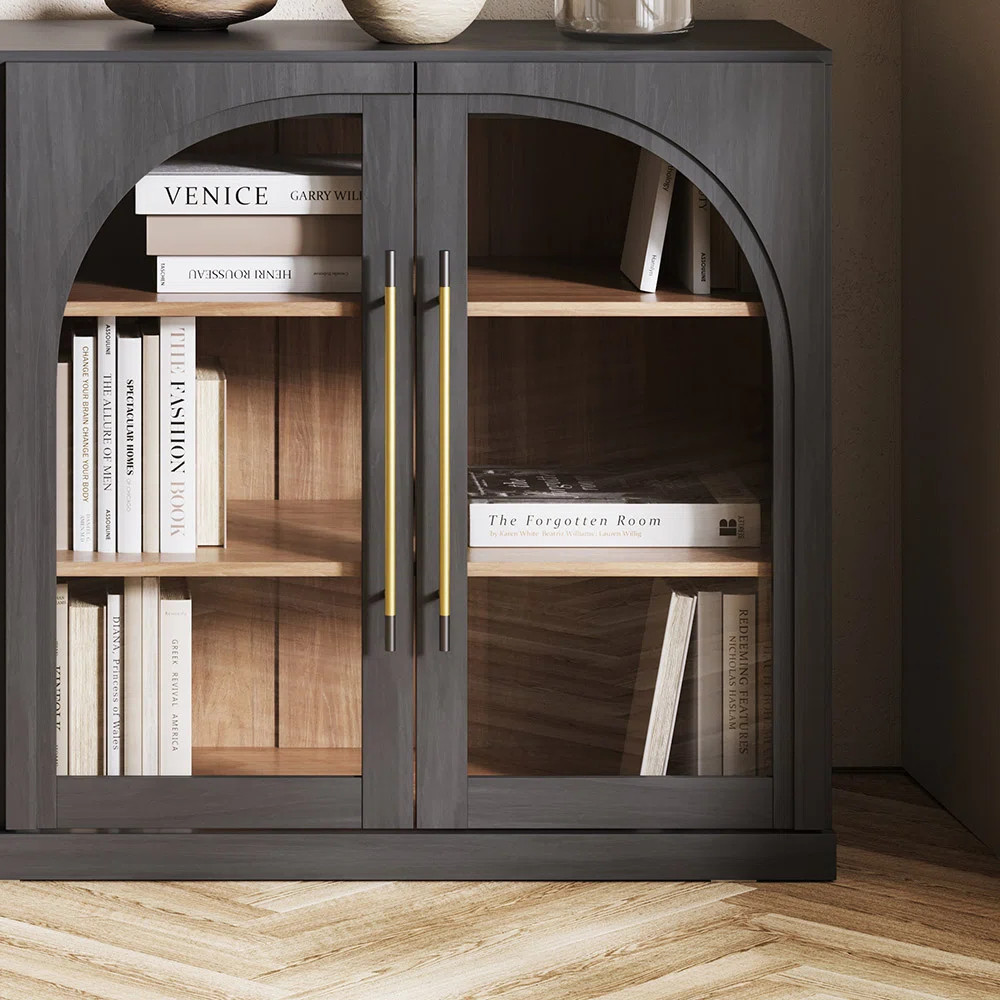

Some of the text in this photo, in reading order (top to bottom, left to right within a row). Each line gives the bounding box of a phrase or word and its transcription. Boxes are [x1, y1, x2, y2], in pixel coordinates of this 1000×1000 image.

[165, 186, 268, 206] VENICE
[290, 190, 331, 201] GARRY
[188, 270, 292, 280] HENRI ROUSSEAU
[102, 373, 112, 491] THE ALLURE OF MEN
[126, 379, 135, 441] SPECTACULAR
[170, 328, 186, 537] THE FASHION BOOK
[126, 444, 135, 476] HOMES
[488, 514, 662, 529] The Forgotten Room
[112, 616, 120, 751] DIANA, Princess of Wales
[171, 639, 179, 752] GREEK REVIVAL AMERICA
[728, 635, 736, 730] NICHOLAS HASLAM
[739, 609, 748, 754] REDEEMING FEATURES
